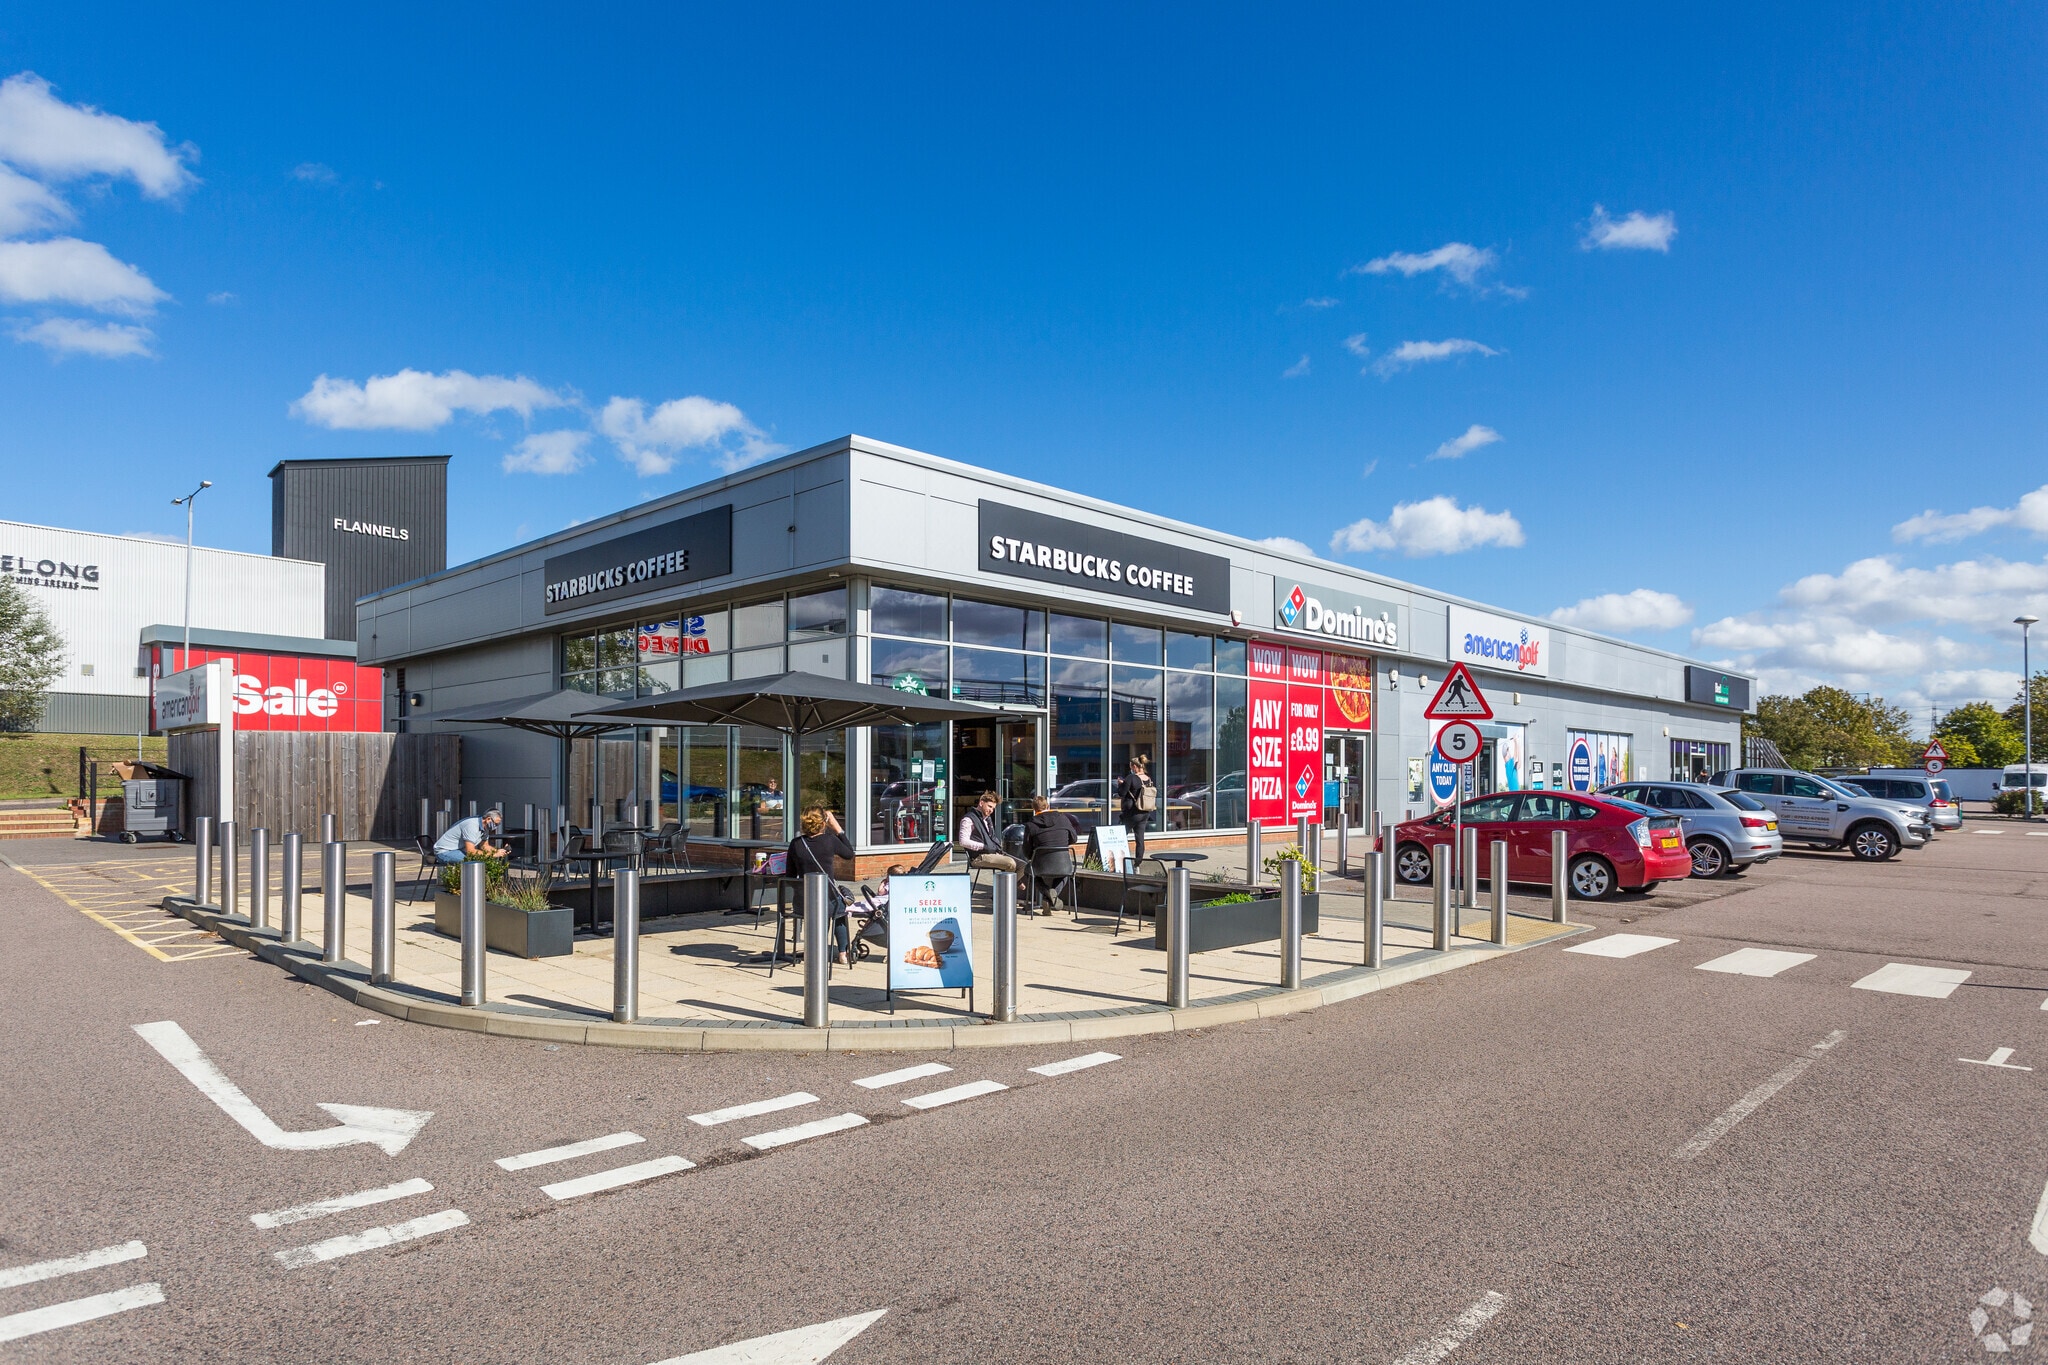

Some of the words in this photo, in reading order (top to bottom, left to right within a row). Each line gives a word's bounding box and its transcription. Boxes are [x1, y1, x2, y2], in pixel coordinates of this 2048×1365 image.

[333, 517, 409, 541] FLANNELS
[0, 554, 99, 582] ELONG
[546, 565, 624, 603] STARBUCKS
[627, 549, 688, 583] COFFEE
[990, 535, 1121, 582] STARBUCKS
[1126, 563, 1194, 596] COFFEE
[44, 579, 79, 590] ARENAS
[1305, 596, 1397, 645] Domino's
[1253, 648, 1282, 675] WOW
[1292, 653, 1319, 679] WOW
[233, 673, 339, 718] Sale
[1252, 699, 1282, 730] ANY
[1291, 702, 1303, 717] FOR
[1304, 704, 1319, 719] ONLY
[1252, 736, 1282, 768] SIZE
[1290, 727, 1319, 752] £8.99
[1452, 733, 1466, 750] 5
[1432, 763, 1443, 773] ANY
[1443, 763, 1457, 773] CLUB
[1436, 775, 1453, 786] TODAY
[1252, 777, 1283, 800] PIZZA
[1292, 800, 1317, 810] Domino's
[922, 906, 958, 914] MORNING
